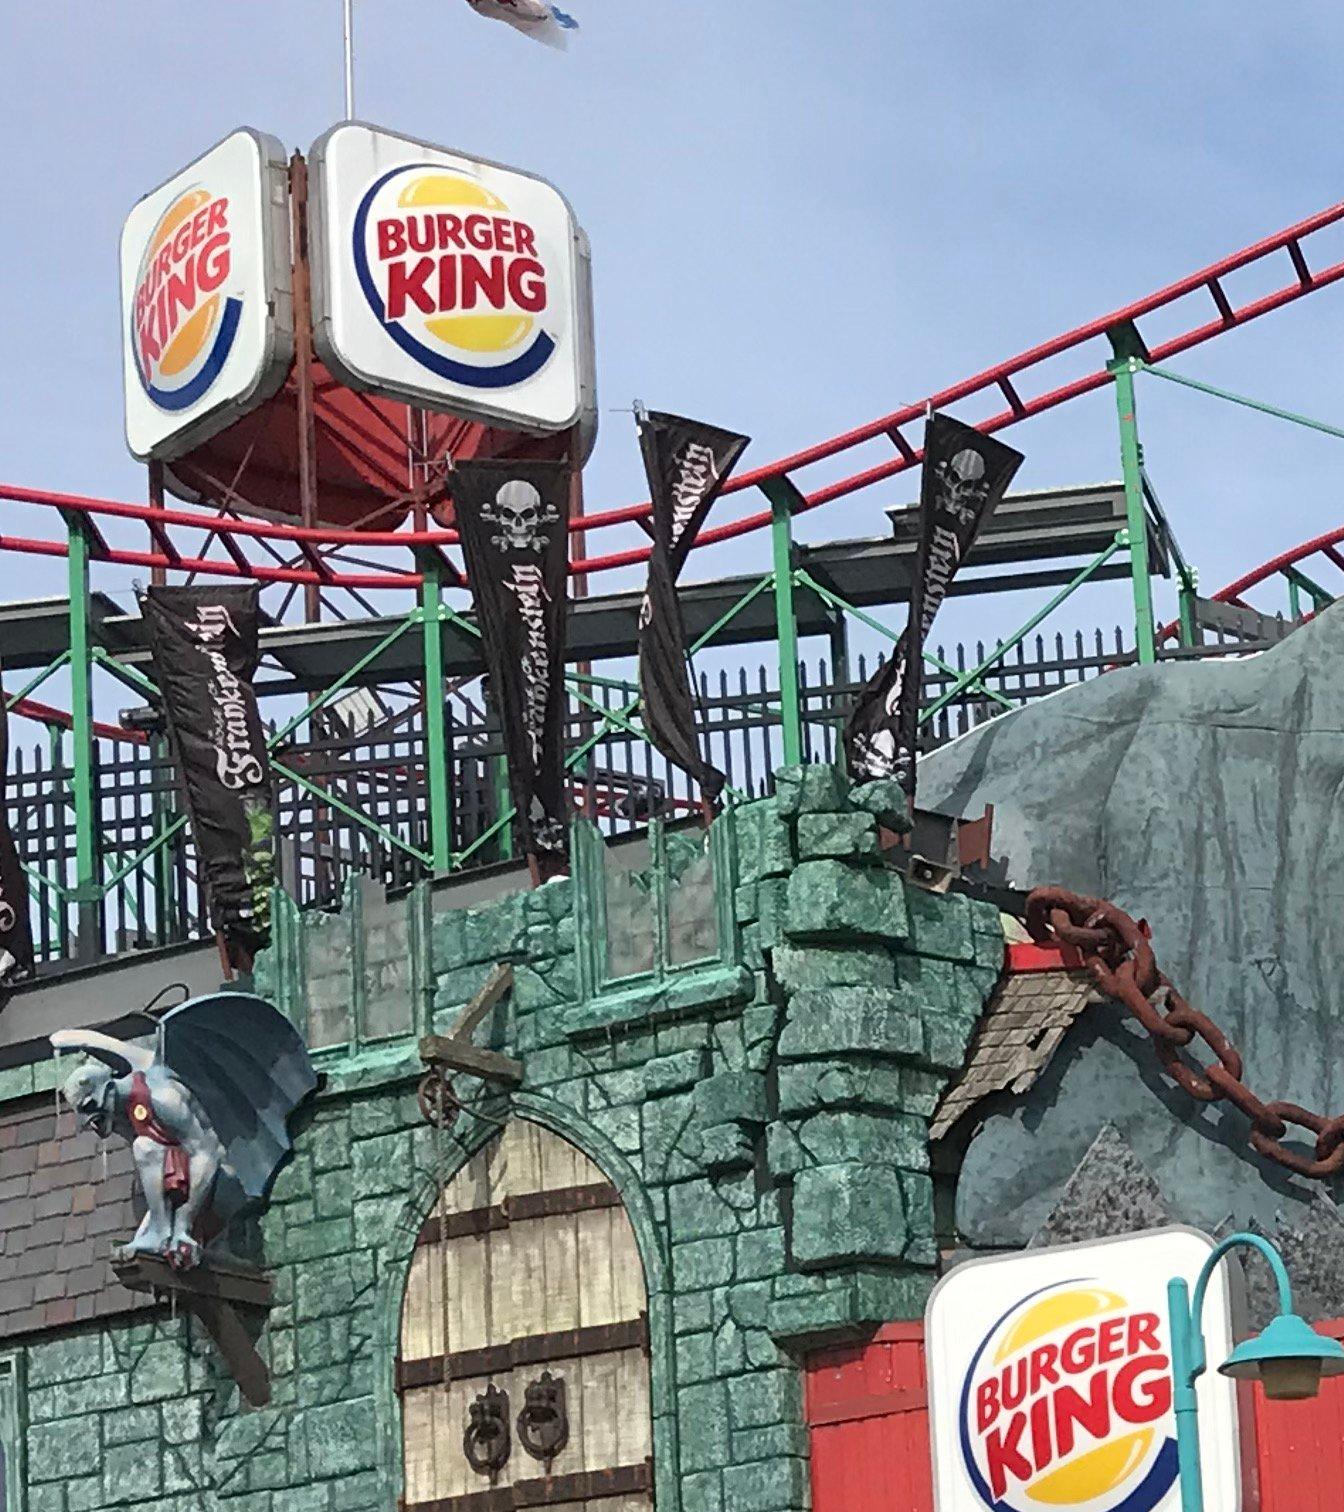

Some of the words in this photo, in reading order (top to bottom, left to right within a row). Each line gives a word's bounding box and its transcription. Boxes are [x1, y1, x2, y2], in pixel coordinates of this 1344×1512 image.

[136, 197, 229, 332] BURGER
[377, 212, 538, 262] BURGER
[384, 252, 547, 322] KING
[139, 230, 231, 384] KING
[976, 1311, 1162, 1432] BURGER
[984, 1354, 1172, 1502] KING
